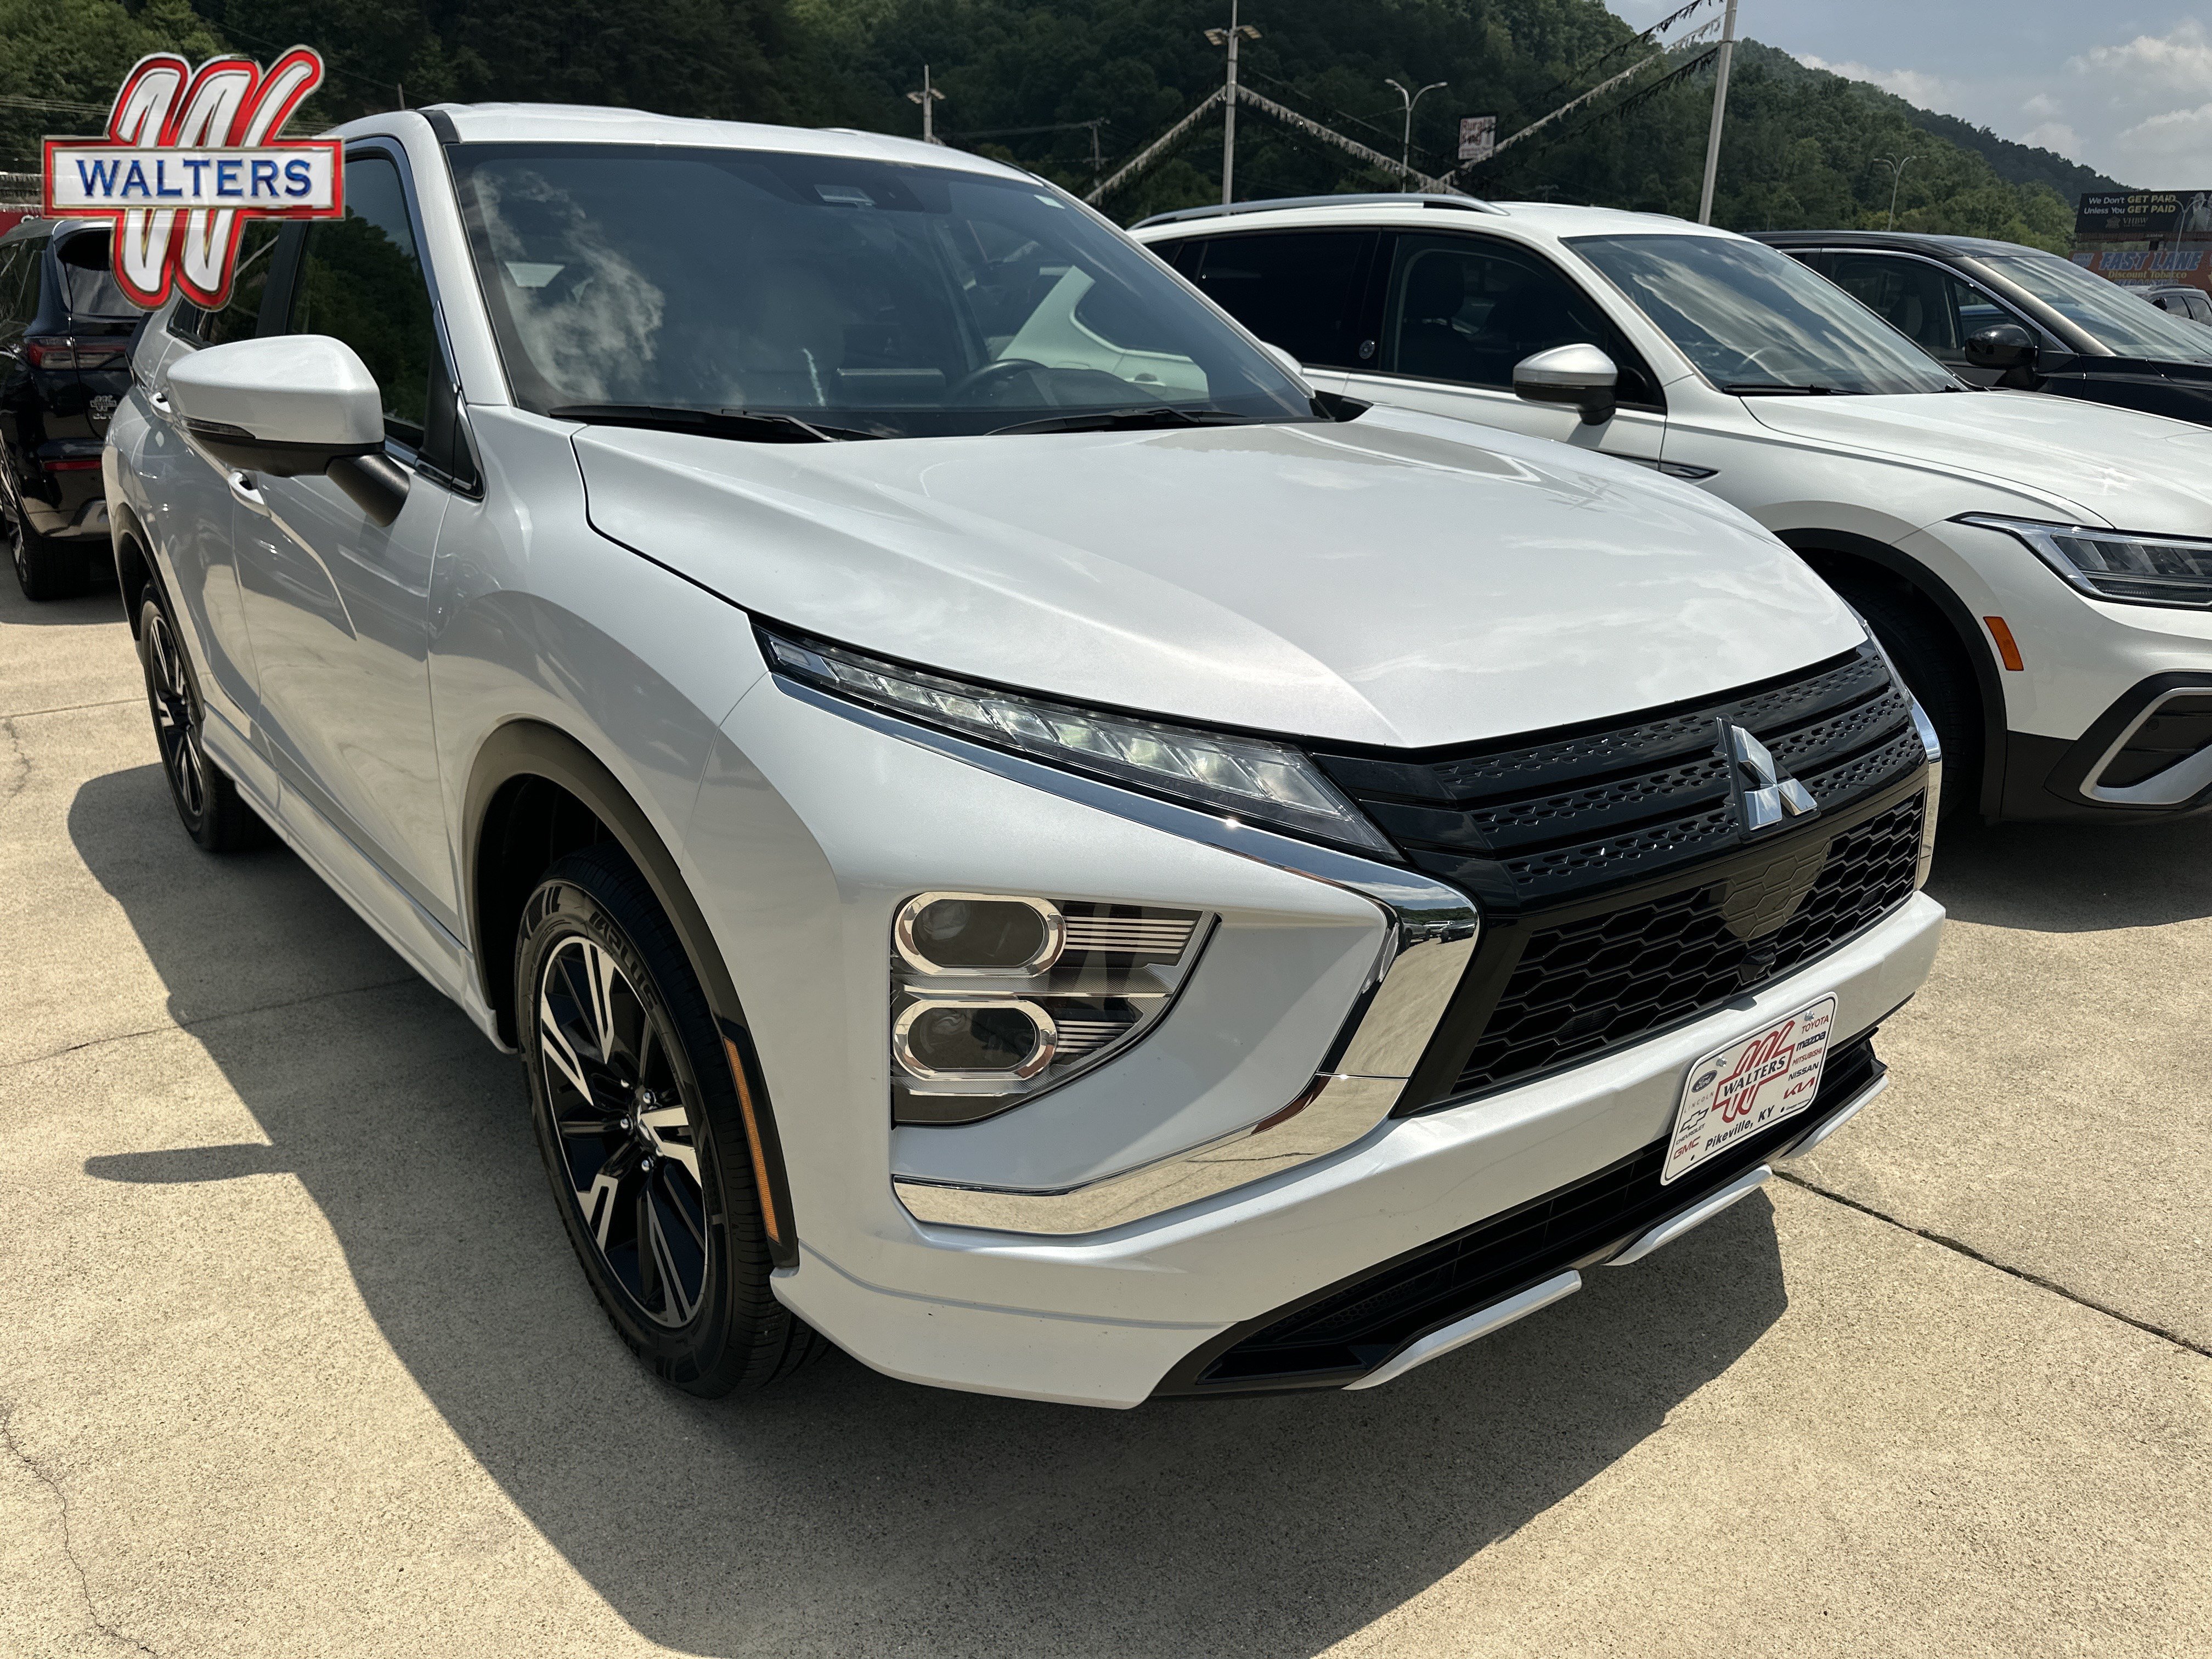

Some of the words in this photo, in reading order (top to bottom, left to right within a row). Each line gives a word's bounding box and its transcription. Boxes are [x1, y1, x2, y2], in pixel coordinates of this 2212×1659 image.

[2128, 195, 2149, 204] GET
[2151, 194, 2176, 203] PAID
[2127, 205, 2149, 213] GET
[2151, 205, 2176, 213] PAID
[2098, 251, 2150, 270] FAST
[2149, 251, 2204, 270] LANE
[2108, 270, 2147, 279] Discount
[2150, 270, 2187, 279] Tobacco
[1801, 1015, 1829, 1034] TOYOTA
[1792, 1047, 1822, 1066] MITSUBISHI
[1724, 1056, 1786, 1097] WALTERS
[1788, 1062, 1819, 1081] NISSAN
[1684, 1091, 1714, 1114] LINCOLN
[1676, 1123, 1706, 1145] CHEVROLET
[1705, 1120, 1753, 1152] Pikeville,
[1758, 1104, 1775, 1122] KY
[1673, 1136, 1701, 1160] GMC
